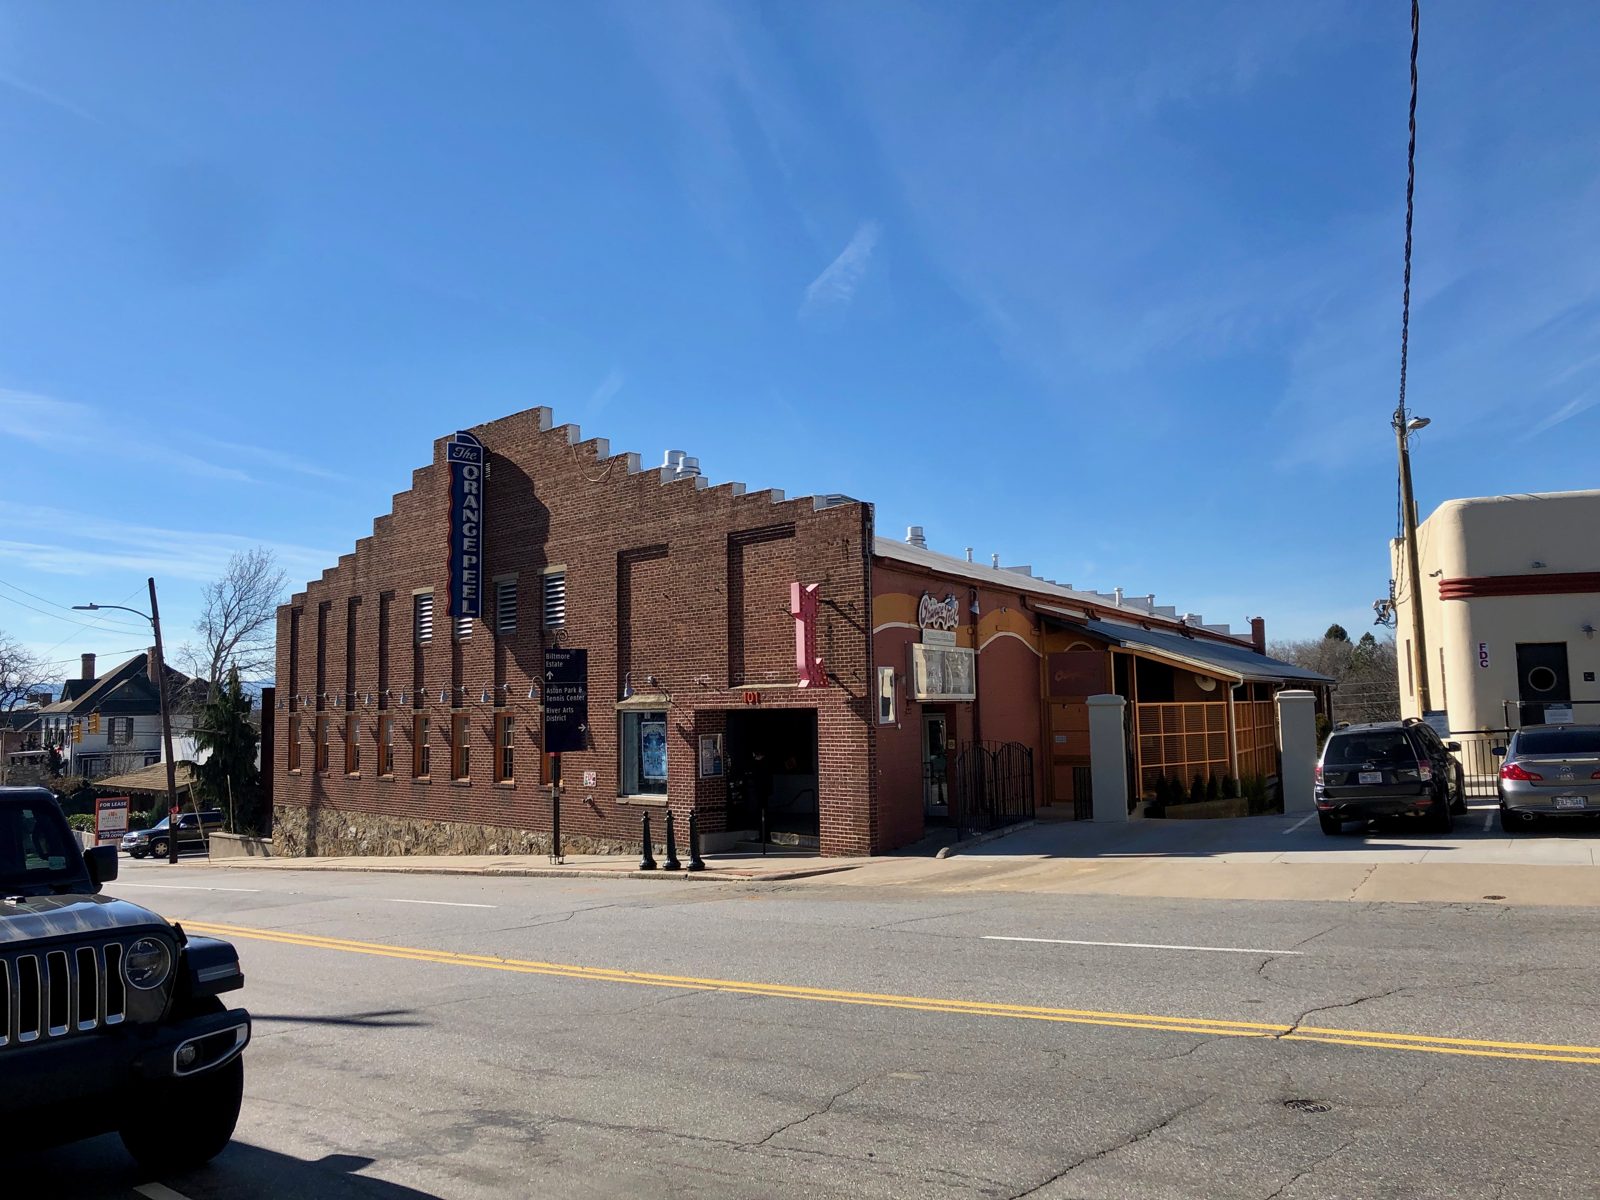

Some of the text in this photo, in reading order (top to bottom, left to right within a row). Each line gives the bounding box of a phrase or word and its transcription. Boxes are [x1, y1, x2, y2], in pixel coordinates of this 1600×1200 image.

[452, 446, 478, 460] The
[462, 465, 479, 614] ORANGE PEEL
[1479, 643, 1489, 668] FDC
